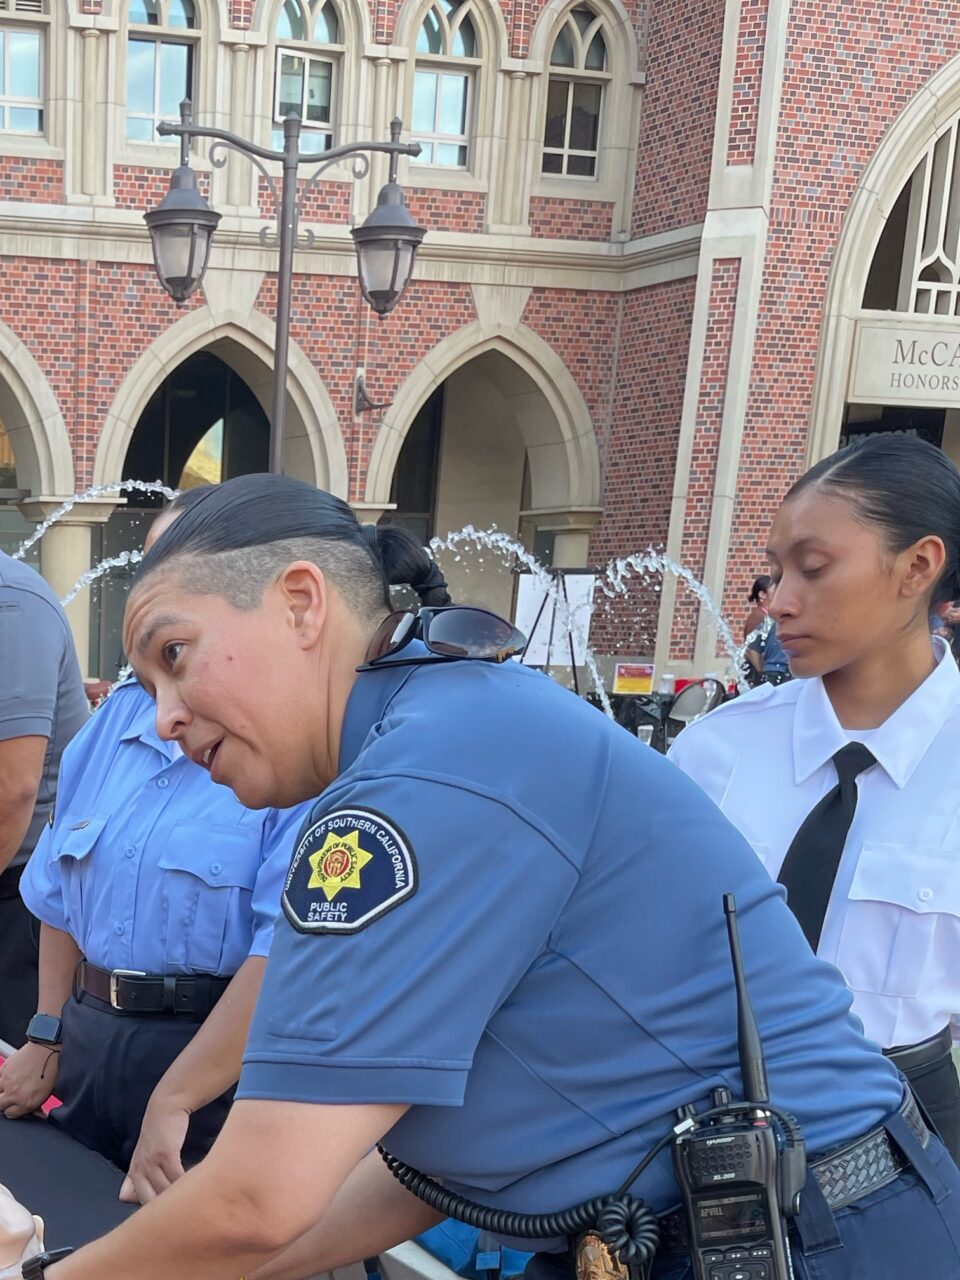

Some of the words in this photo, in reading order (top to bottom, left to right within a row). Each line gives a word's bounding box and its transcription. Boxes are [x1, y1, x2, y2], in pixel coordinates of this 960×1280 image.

[890, 372, 960, 391] HONORS
[314, 824, 326, 837] OF
[327, 817, 378, 835] SOUTHERN
[376, 830, 406, 889] CALIFORNIA
[310, 902, 348, 912] PUBLIC
[307, 911, 348, 922] SAFETY
